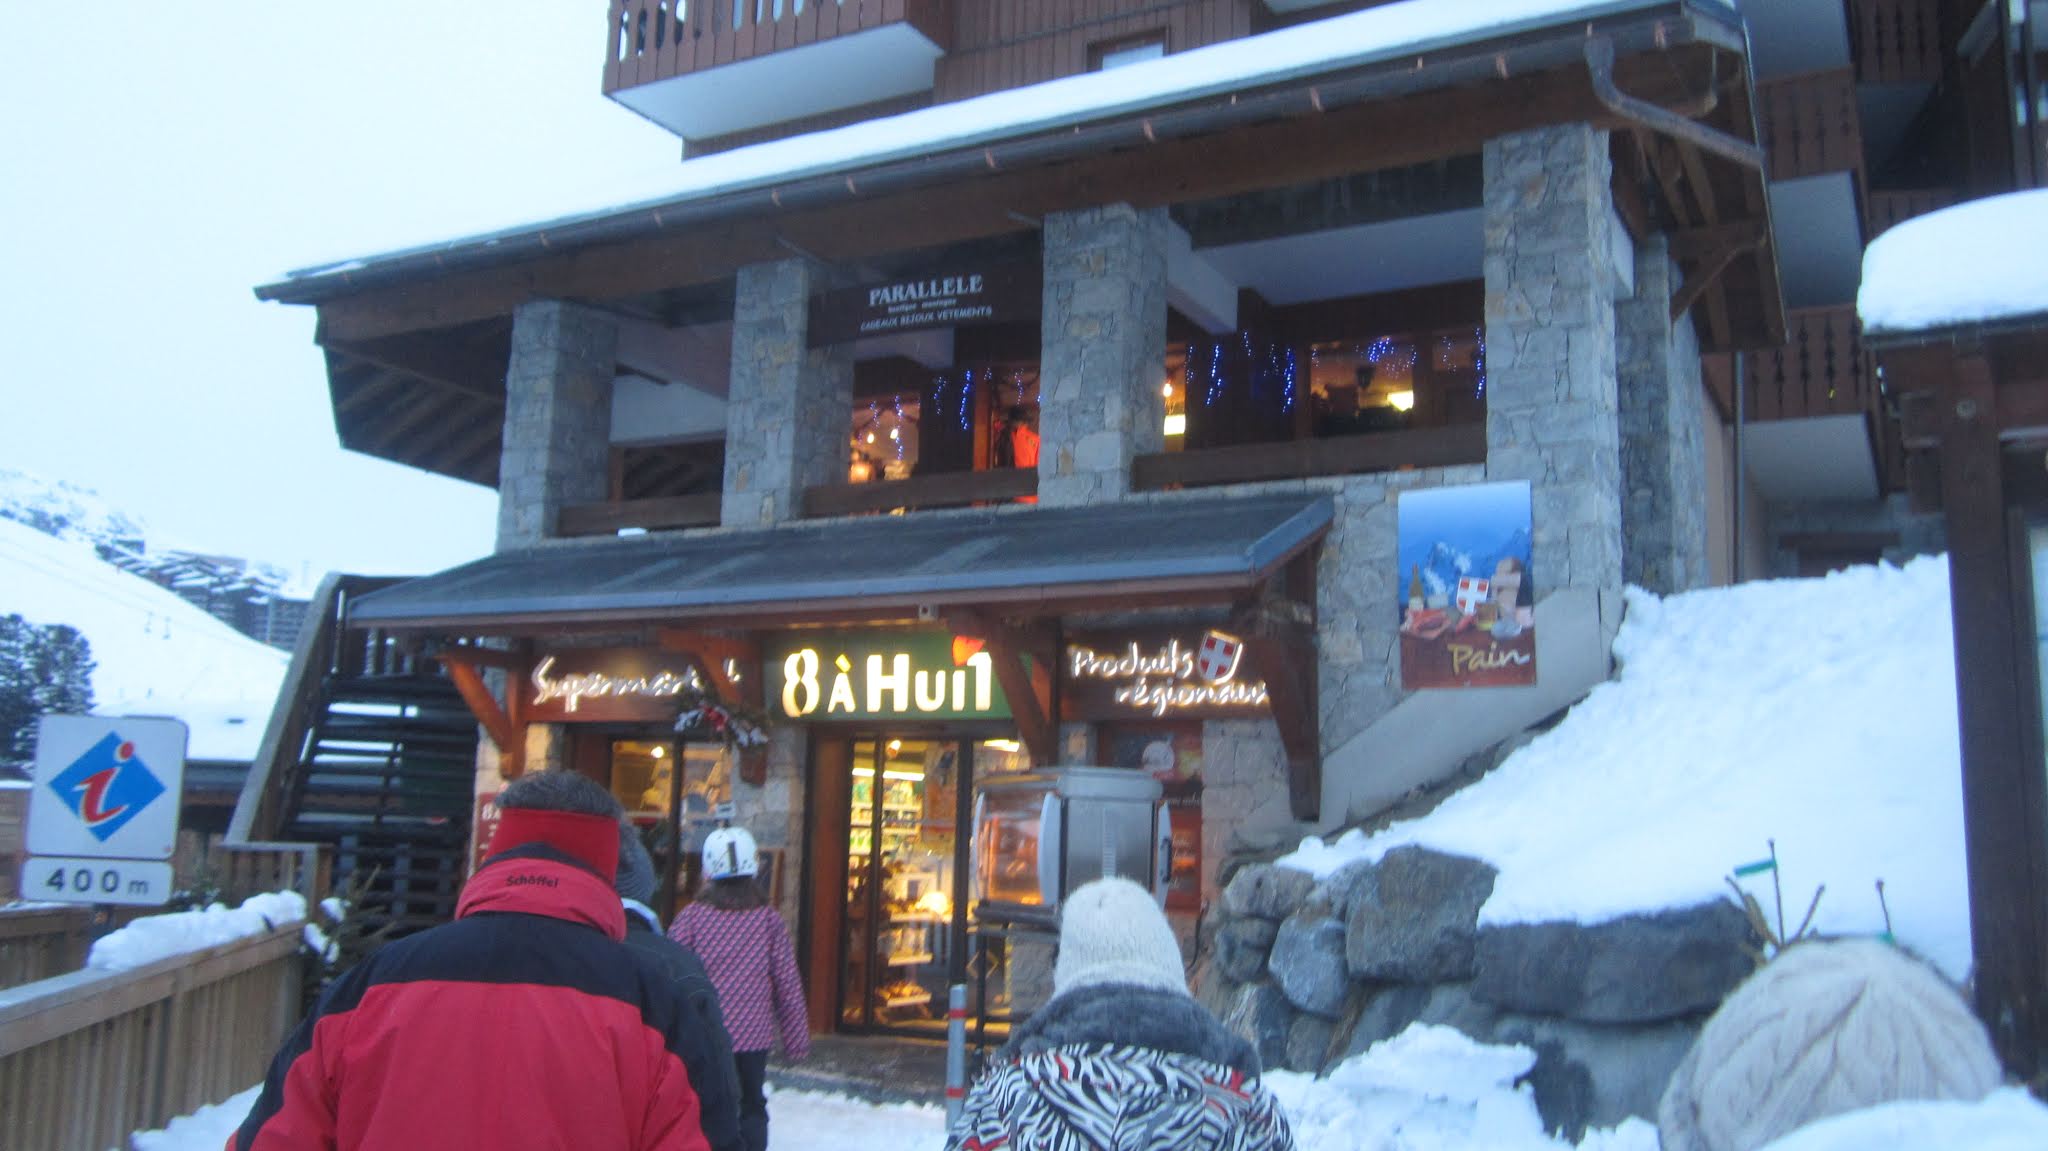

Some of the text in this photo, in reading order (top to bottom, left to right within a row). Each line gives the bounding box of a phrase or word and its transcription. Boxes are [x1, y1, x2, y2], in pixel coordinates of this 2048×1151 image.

[869, 274, 983, 307] PARALLELE
[1068, 637, 1195, 679] Produits
[1447, 641, 1531, 676] Pain
[782, 647, 820, 718] 8
[866, 650, 993, 713] Huit
[46, 867, 120, 893] 400
[505, 873, 560, 889] Schöffel
